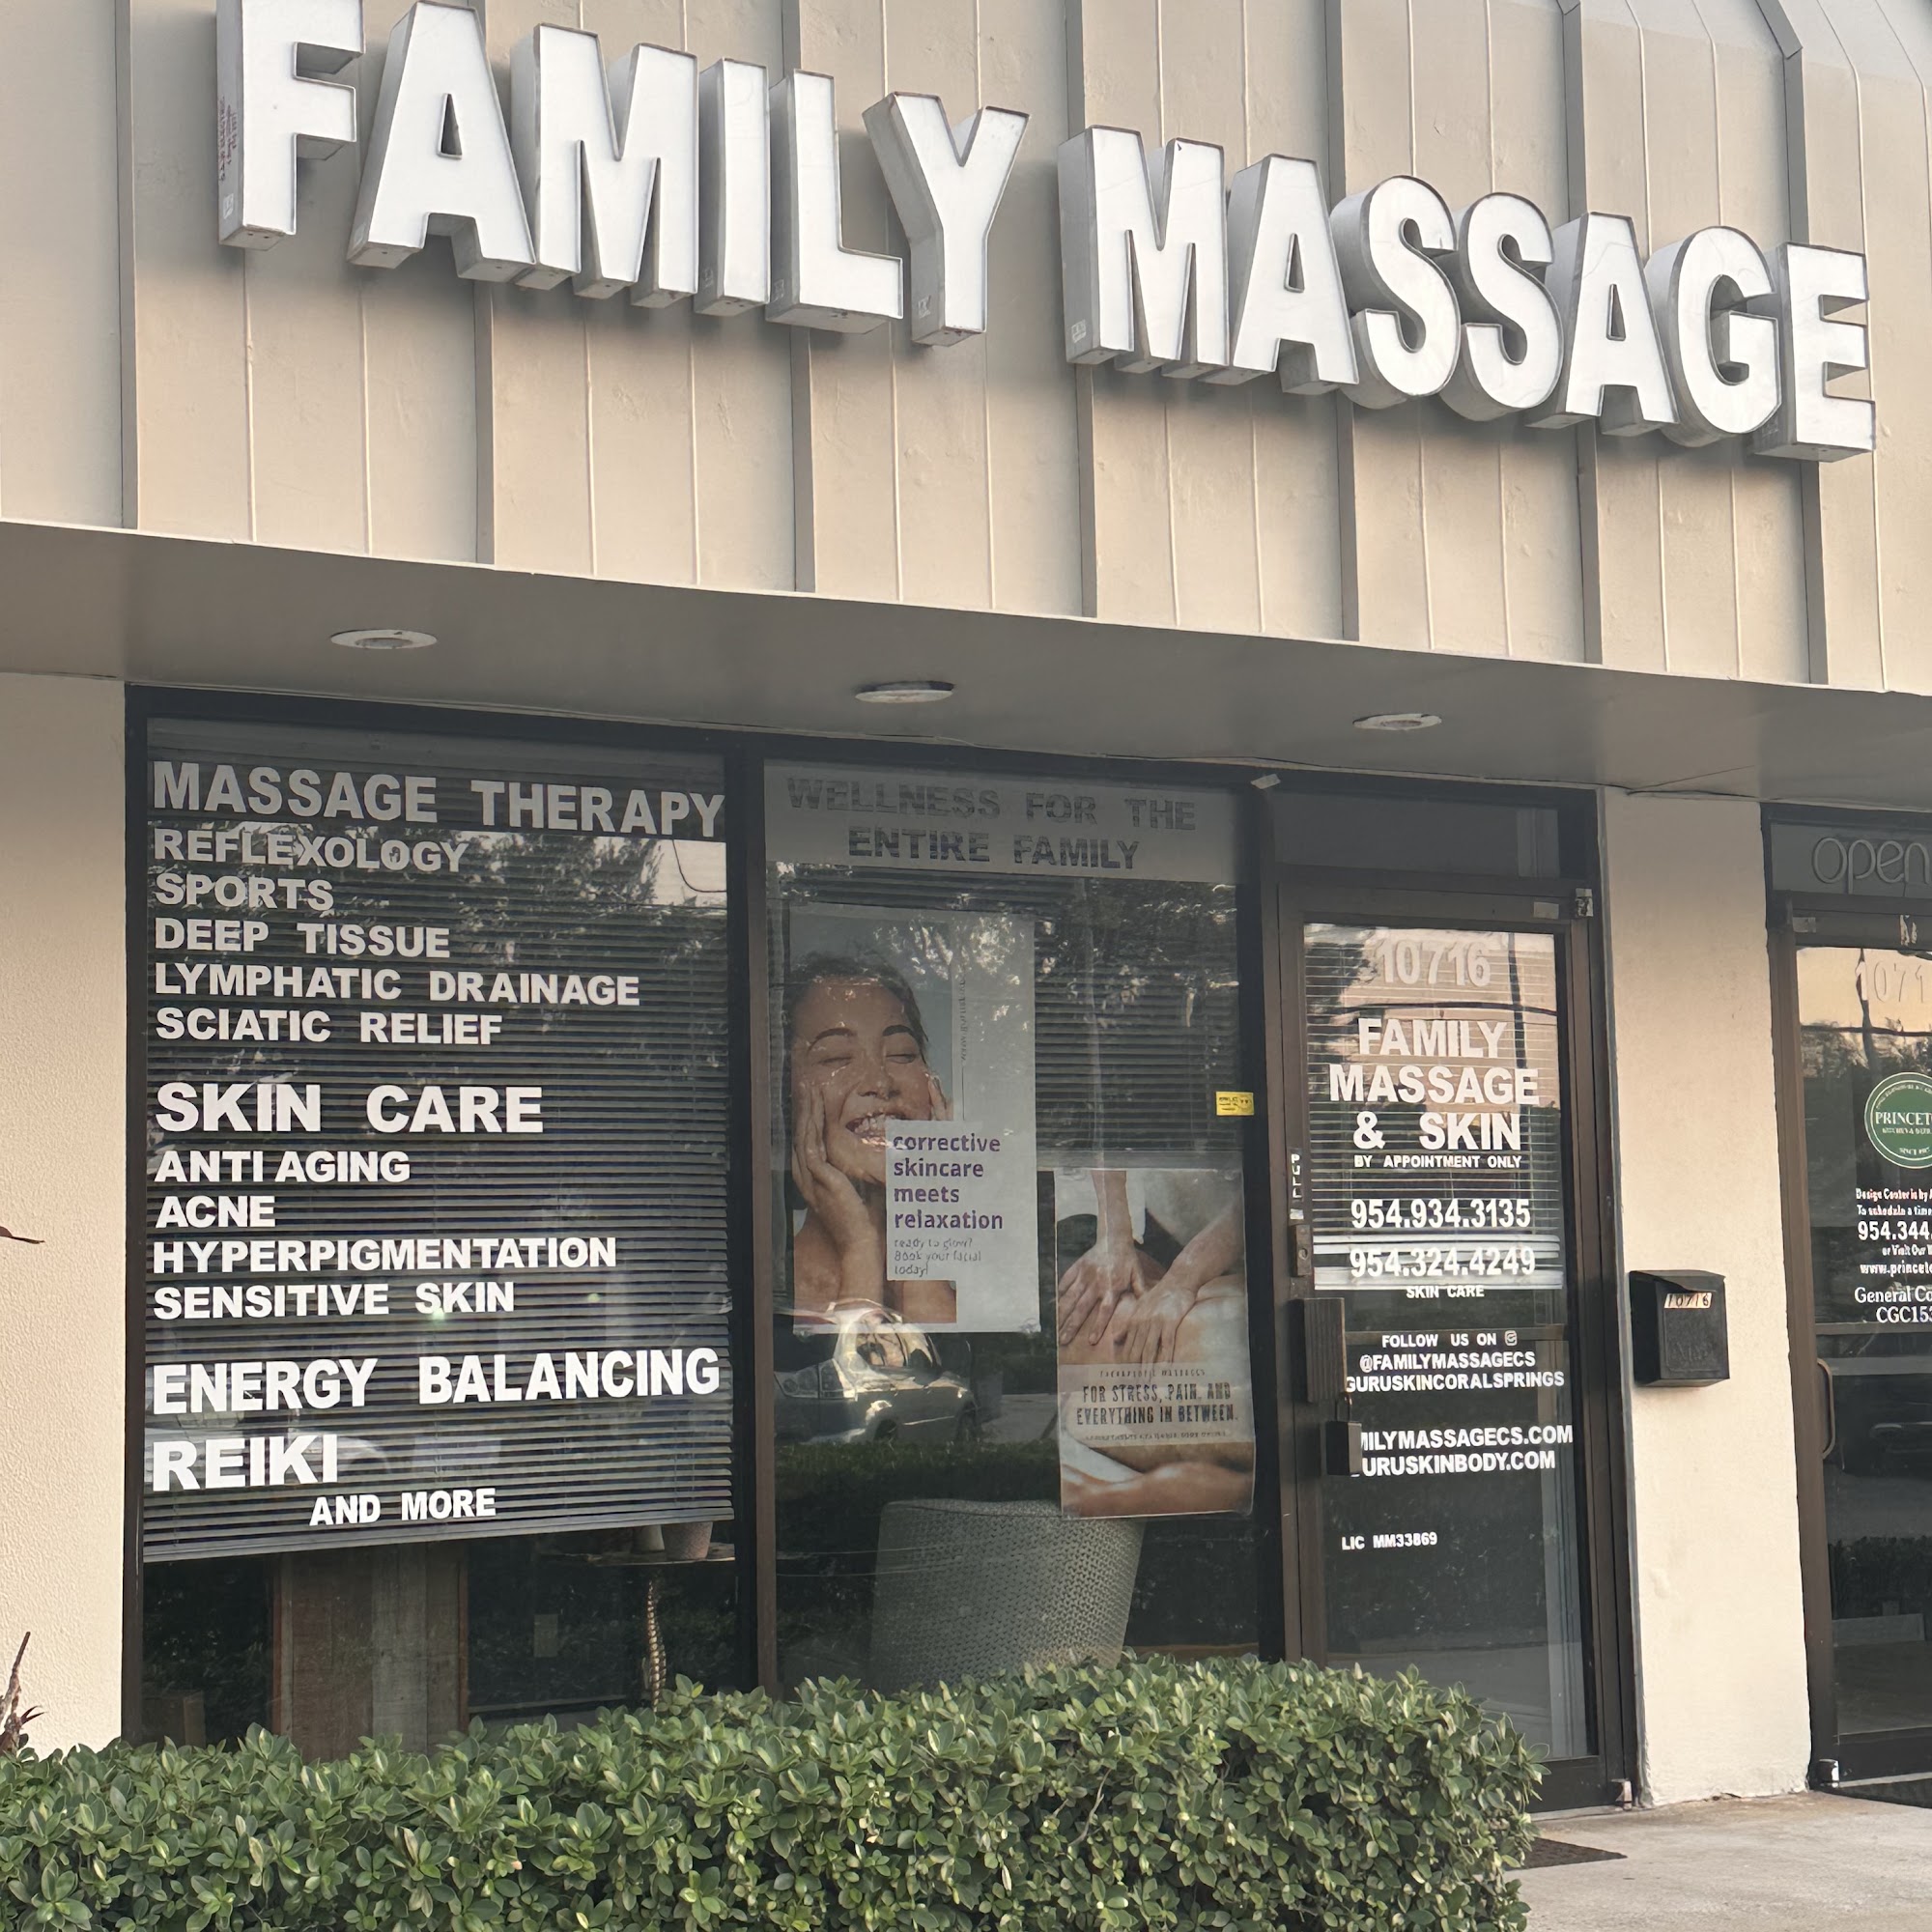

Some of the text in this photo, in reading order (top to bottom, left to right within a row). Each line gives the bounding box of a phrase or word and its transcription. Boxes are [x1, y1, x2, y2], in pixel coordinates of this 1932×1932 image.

[218, 0, 1875, 460] FAMILY MASSAGE
[153, 760, 724, 838] MASSAGE THERAPY
[787, 777, 1197, 831] WELLNESS FOR THE
[154, 829, 470, 873] REFLEXOLOGY
[848, 826, 1141, 869] ENTIRE FAMILY
[155, 873, 334, 912] SPORTS
[155, 917, 451, 959] DEEP TISSUE
[1378, 940, 1492, 988] 10716
[156, 962, 640, 1007] LYMPHATIC DRAINAGE
[156, 1007, 502, 1046] SCIATIC RELIEF
[1357, 1017, 1508, 1059] FAMILY
[1328, 1063, 1541, 1106] MASSAGE
[155, 1081, 544, 1134] SKIN CARE
[1875, 1111, 1932, 1126] PRINCET
[893, 1132, 1001, 1152] corrective
[1352, 1110, 1522, 1151] & SKIN
[154, 1150, 412, 1183] ANTI AGING
[894, 1157, 984, 1178] skincare
[1291, 1153, 1302, 1198] PULL
[1353, 1154, 1522, 1169] BY APPOINTMENT ONLY
[155, 1194, 276, 1229] ACNE
[894, 1186, 960, 1203] meets
[1350, 1198, 1531, 1229] 954.934.3135
[894, 1208, 1004, 1230] relaxation
[153, 1236, 617, 1274] HYPERPIGMENTATION
[1350, 1246, 1536, 1277] 954.324.4249
[153, 1281, 515, 1321] SENSITIVE SKIN
[1406, 1284, 1486, 1299] SKIN CARE
[1855, 1285, 1912, 1303] General
[1381, 1332, 1497, 1349] FOLLOW US ON
[1359, 1350, 1536, 1373] @FAMILYMASSAGECS
[153, 1348, 721, 1415] ENERGY BALANCING
[1082, 1384, 1106, 1404] FOR
[1207, 1381, 1232, 1401] AND
[1346, 1371, 1565, 1393] GURUSKINCORALSPRINGS
[1076, 1406, 1155, 1426] EVERYTHING
[1159, 1406, 1173, 1423] IN
[152, 1433, 338, 1492] REIKI
[1350, 1450, 1556, 1478] URUSKINBODY.COM
[308, 1488, 497, 1527] AND MORE
[1341, 1535, 1366, 1550] LIC
